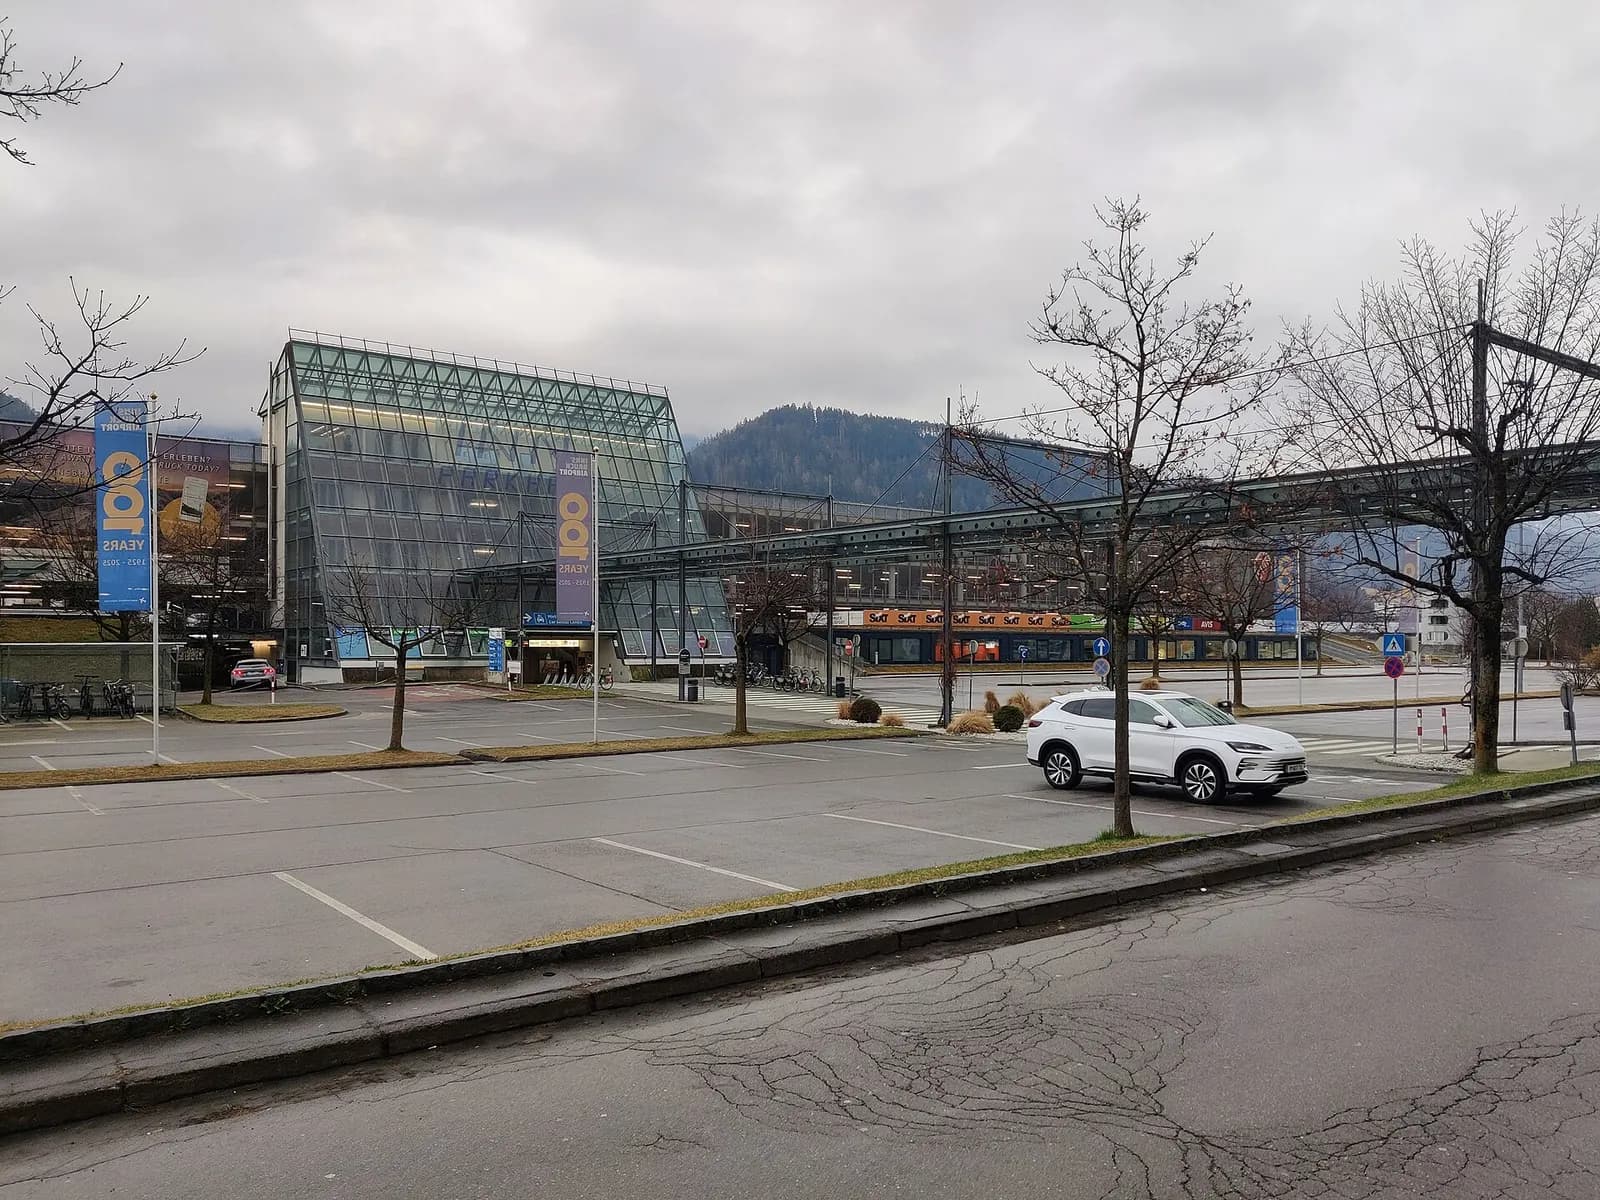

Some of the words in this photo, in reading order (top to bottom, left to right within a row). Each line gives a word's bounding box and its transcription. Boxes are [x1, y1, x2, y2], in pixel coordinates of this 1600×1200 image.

[163, 453, 211, 464] ERLEBEN?
[186, 463, 220, 473] TODAY?
[869, 613, 888, 623] SIXT
[898, 613, 917, 624] SIXT
[926, 614, 944, 624] SIXT
[953, 615, 970, 624] SIXT
[979, 616, 995, 624] SIXT
[1003, 616, 1020, 625] SIXT
[1028, 617, 1043, 625] SIXT
[1200, 621, 1213, 629] AVIS
